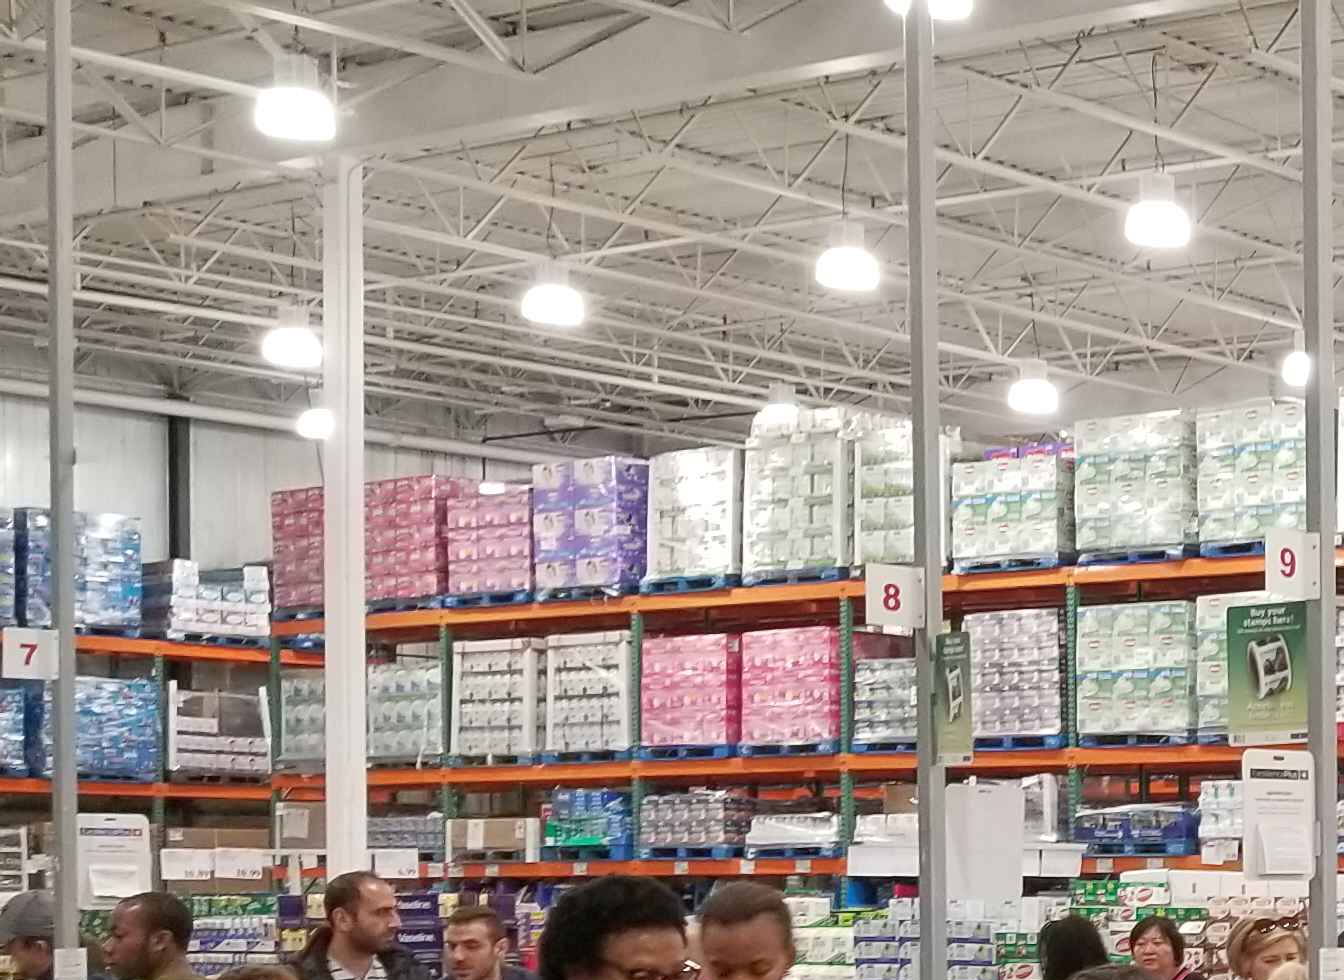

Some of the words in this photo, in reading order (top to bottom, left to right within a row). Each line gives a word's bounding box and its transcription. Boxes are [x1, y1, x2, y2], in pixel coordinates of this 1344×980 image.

[1280, 548, 1296, 577] 9
[883, 583, 901, 611] 8
[20, 644, 38, 666] 7
